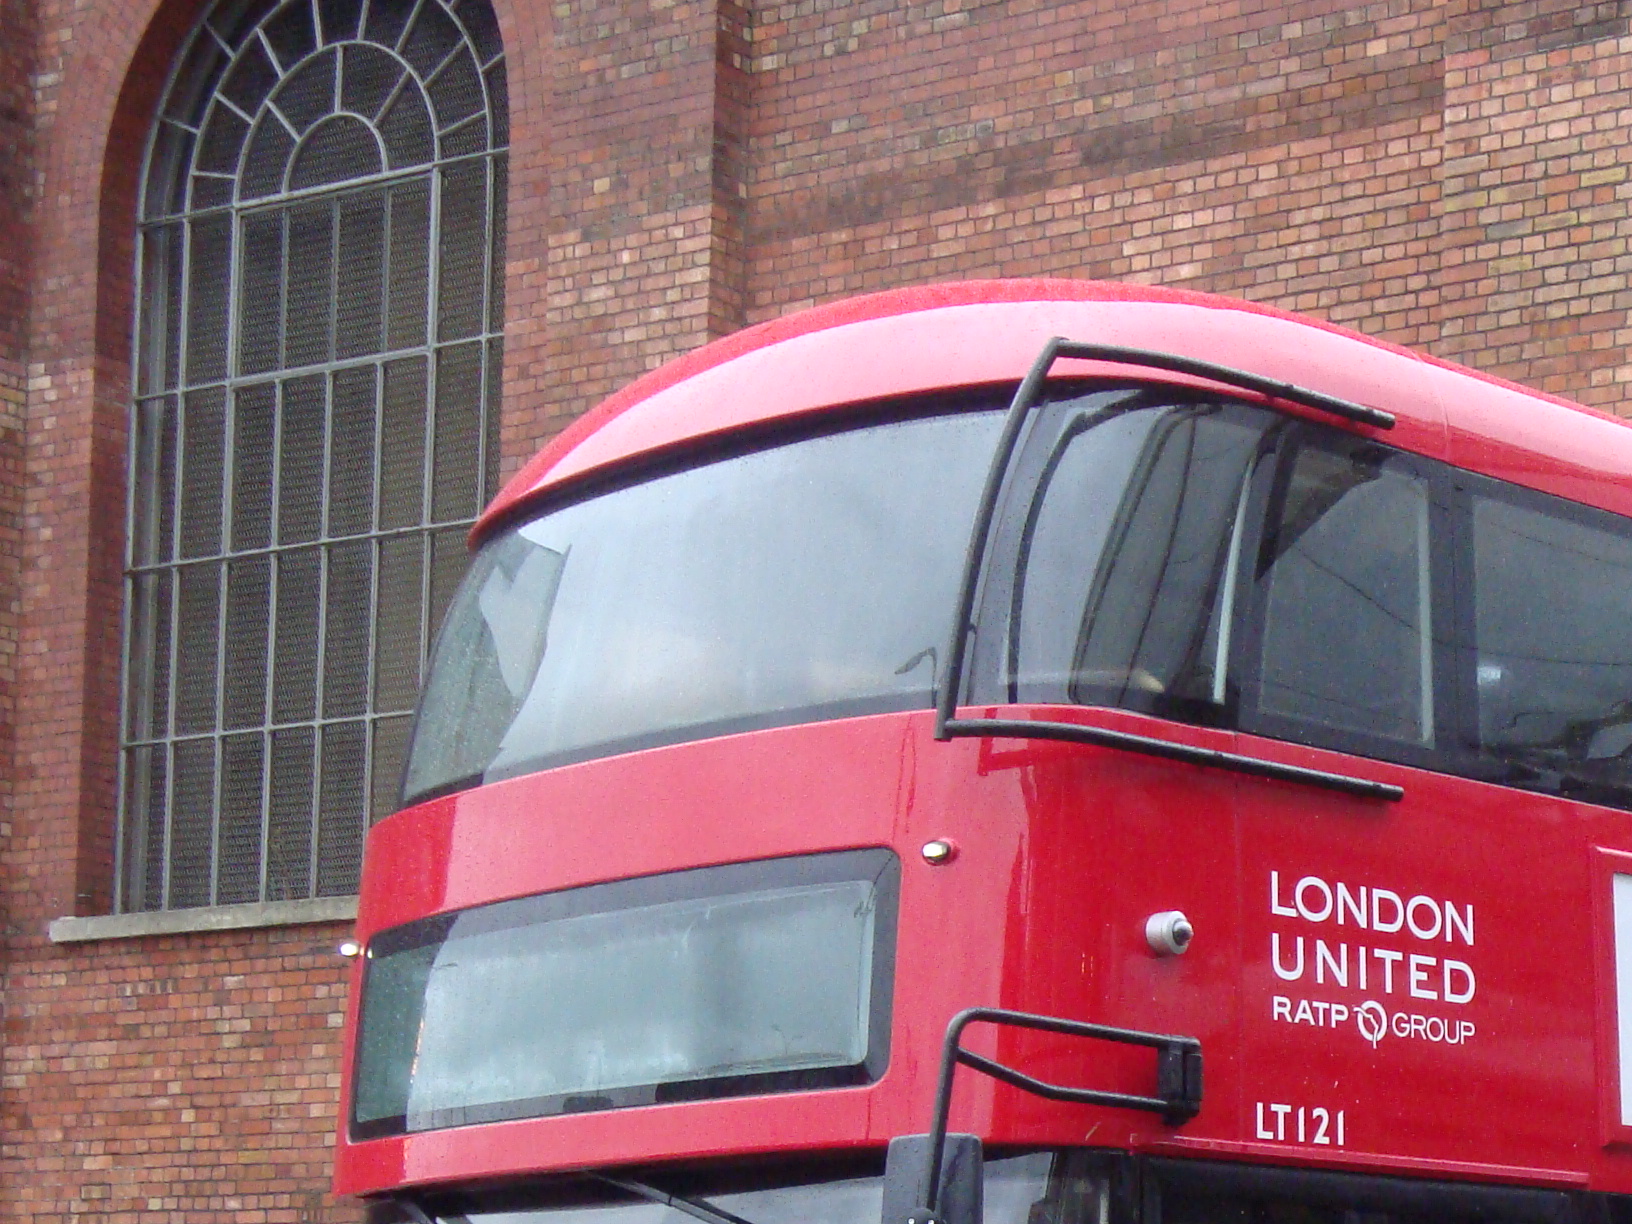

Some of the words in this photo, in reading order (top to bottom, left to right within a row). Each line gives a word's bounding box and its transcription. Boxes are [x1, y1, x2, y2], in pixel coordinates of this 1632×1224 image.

[1271, 870, 1475, 947] LONDON
[1271, 932, 1477, 1005] UNITED
[1273, 995, 1349, 1029] RATP
[1392, 1012, 1476, 1046] GROUP
[1256, 1102, 1347, 1146] LT121
